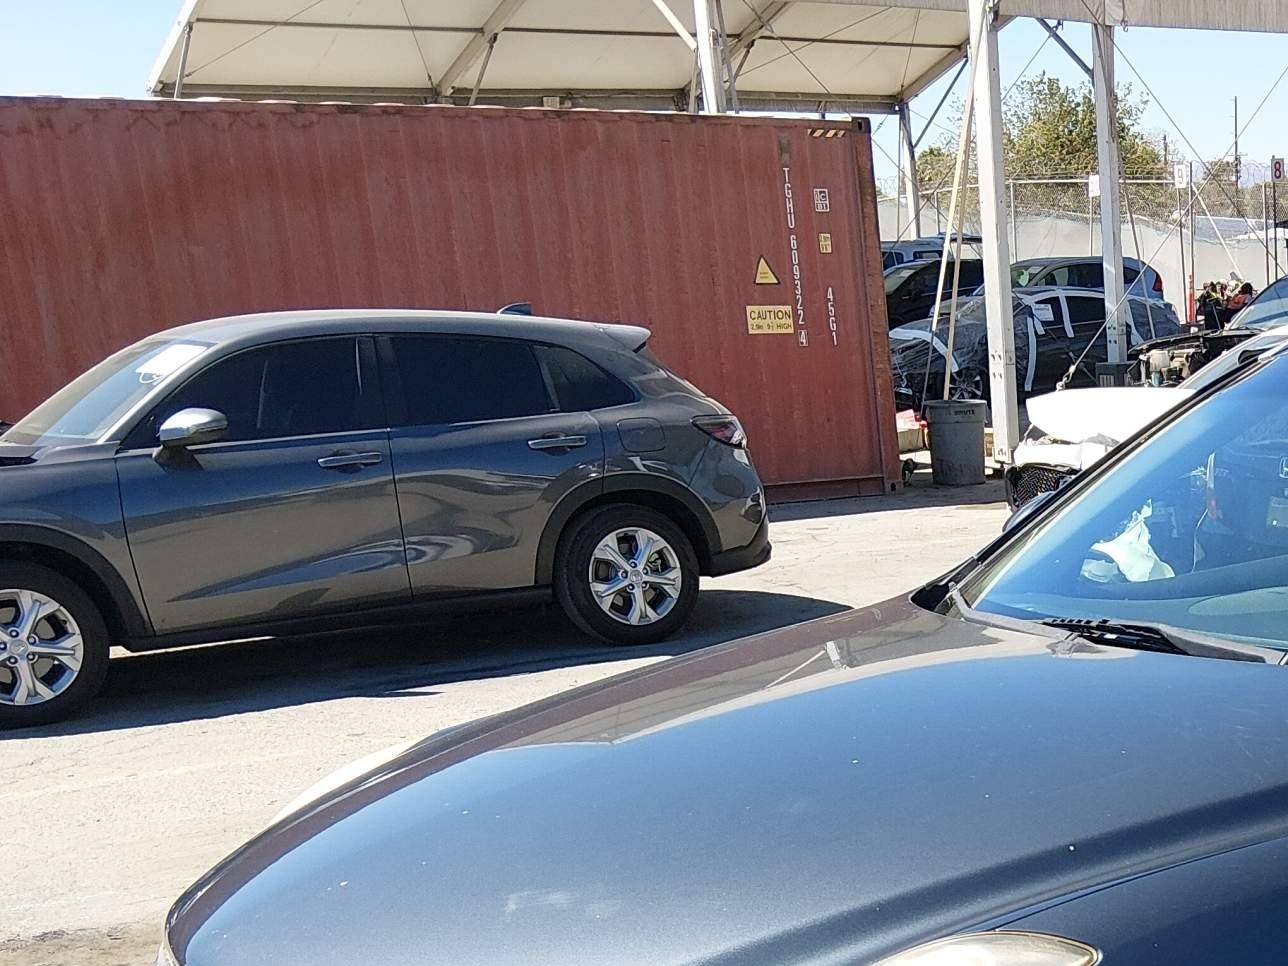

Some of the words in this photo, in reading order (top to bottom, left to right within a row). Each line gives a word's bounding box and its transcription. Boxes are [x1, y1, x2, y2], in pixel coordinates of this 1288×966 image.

[1176, 167, 1184, 183] 9
[1273, 160, 1282, 180] 8
[782, 167, 794, 229] TGHU
[789, 235, 804, 325] 609322
[800, 331, 808, 346] 4
[750, 310, 791, 321] CAUTION
[826, 287, 838, 345] 45G1
[776, 323, 792, 331] HIGH
